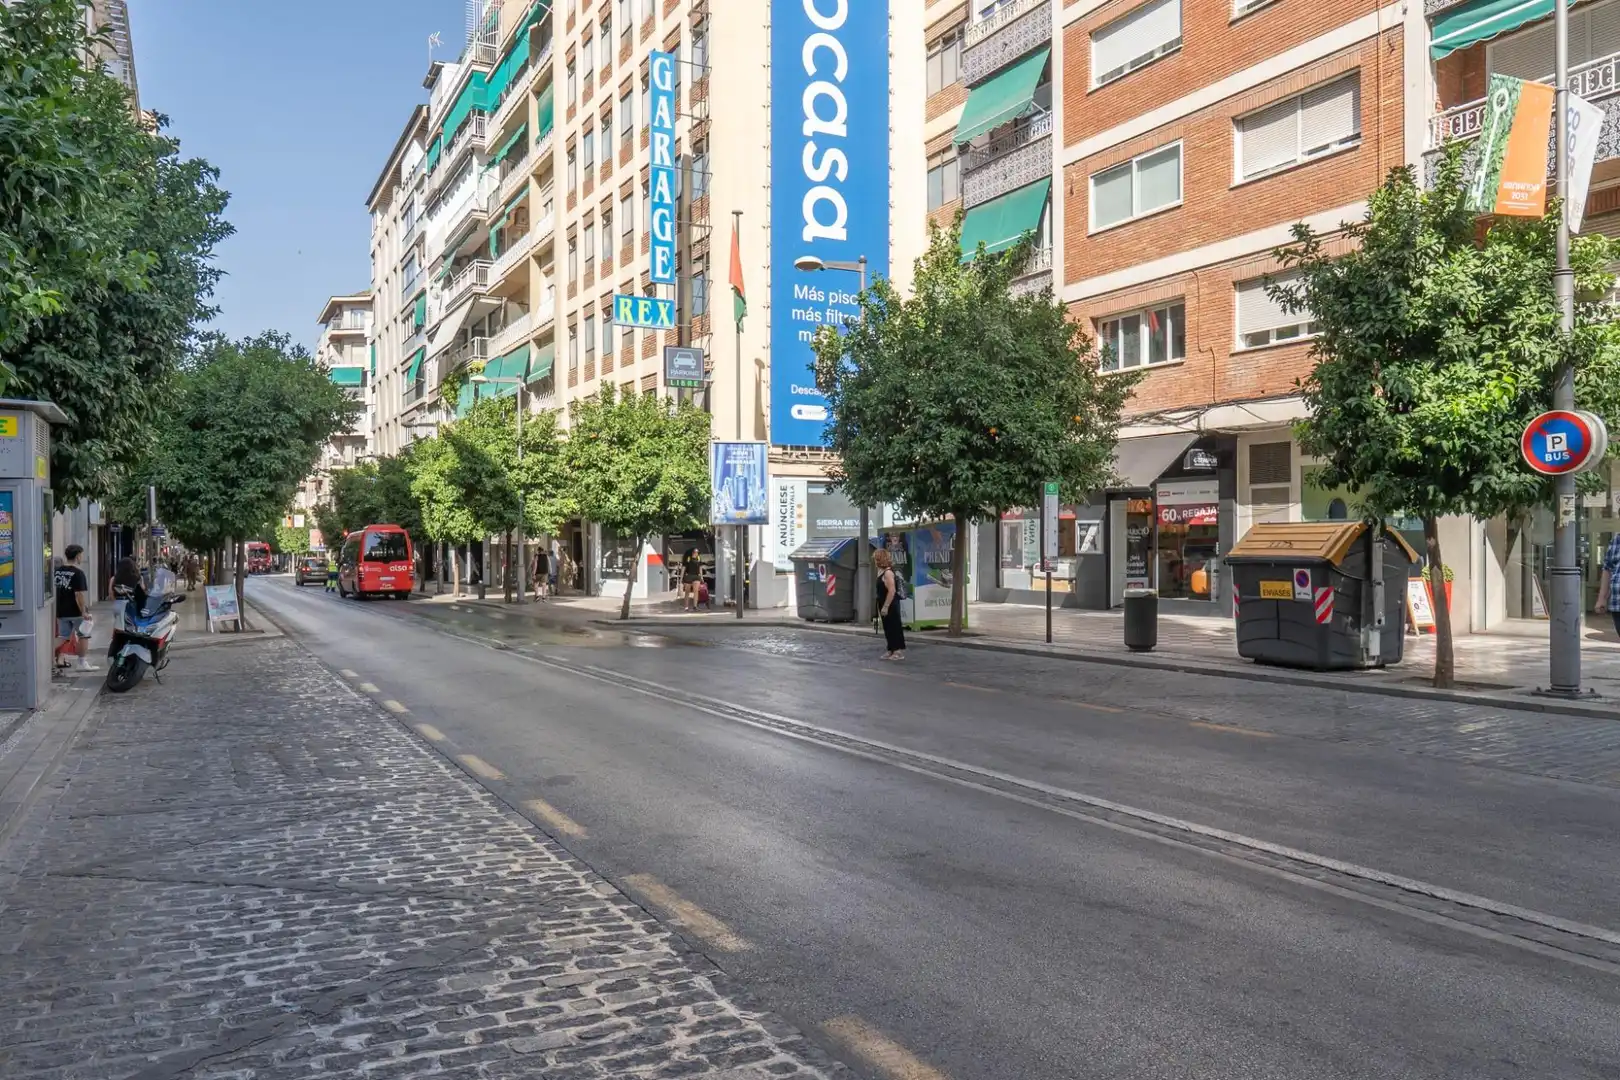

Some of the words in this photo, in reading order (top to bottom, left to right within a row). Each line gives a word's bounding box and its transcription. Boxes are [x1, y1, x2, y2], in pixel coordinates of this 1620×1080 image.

[652, 57, 674, 279] GARAGE
[793, 283, 825, 302] Más
[618, 297, 673, 328] REX
[791, 306, 822, 322] más
[1552, 435, 1563, 449] P
[1545, 451, 1570, 462] BUS
[778, 485, 788, 546] ANÚNCIESE
[1262, 588, 1291, 597] ENVASES
